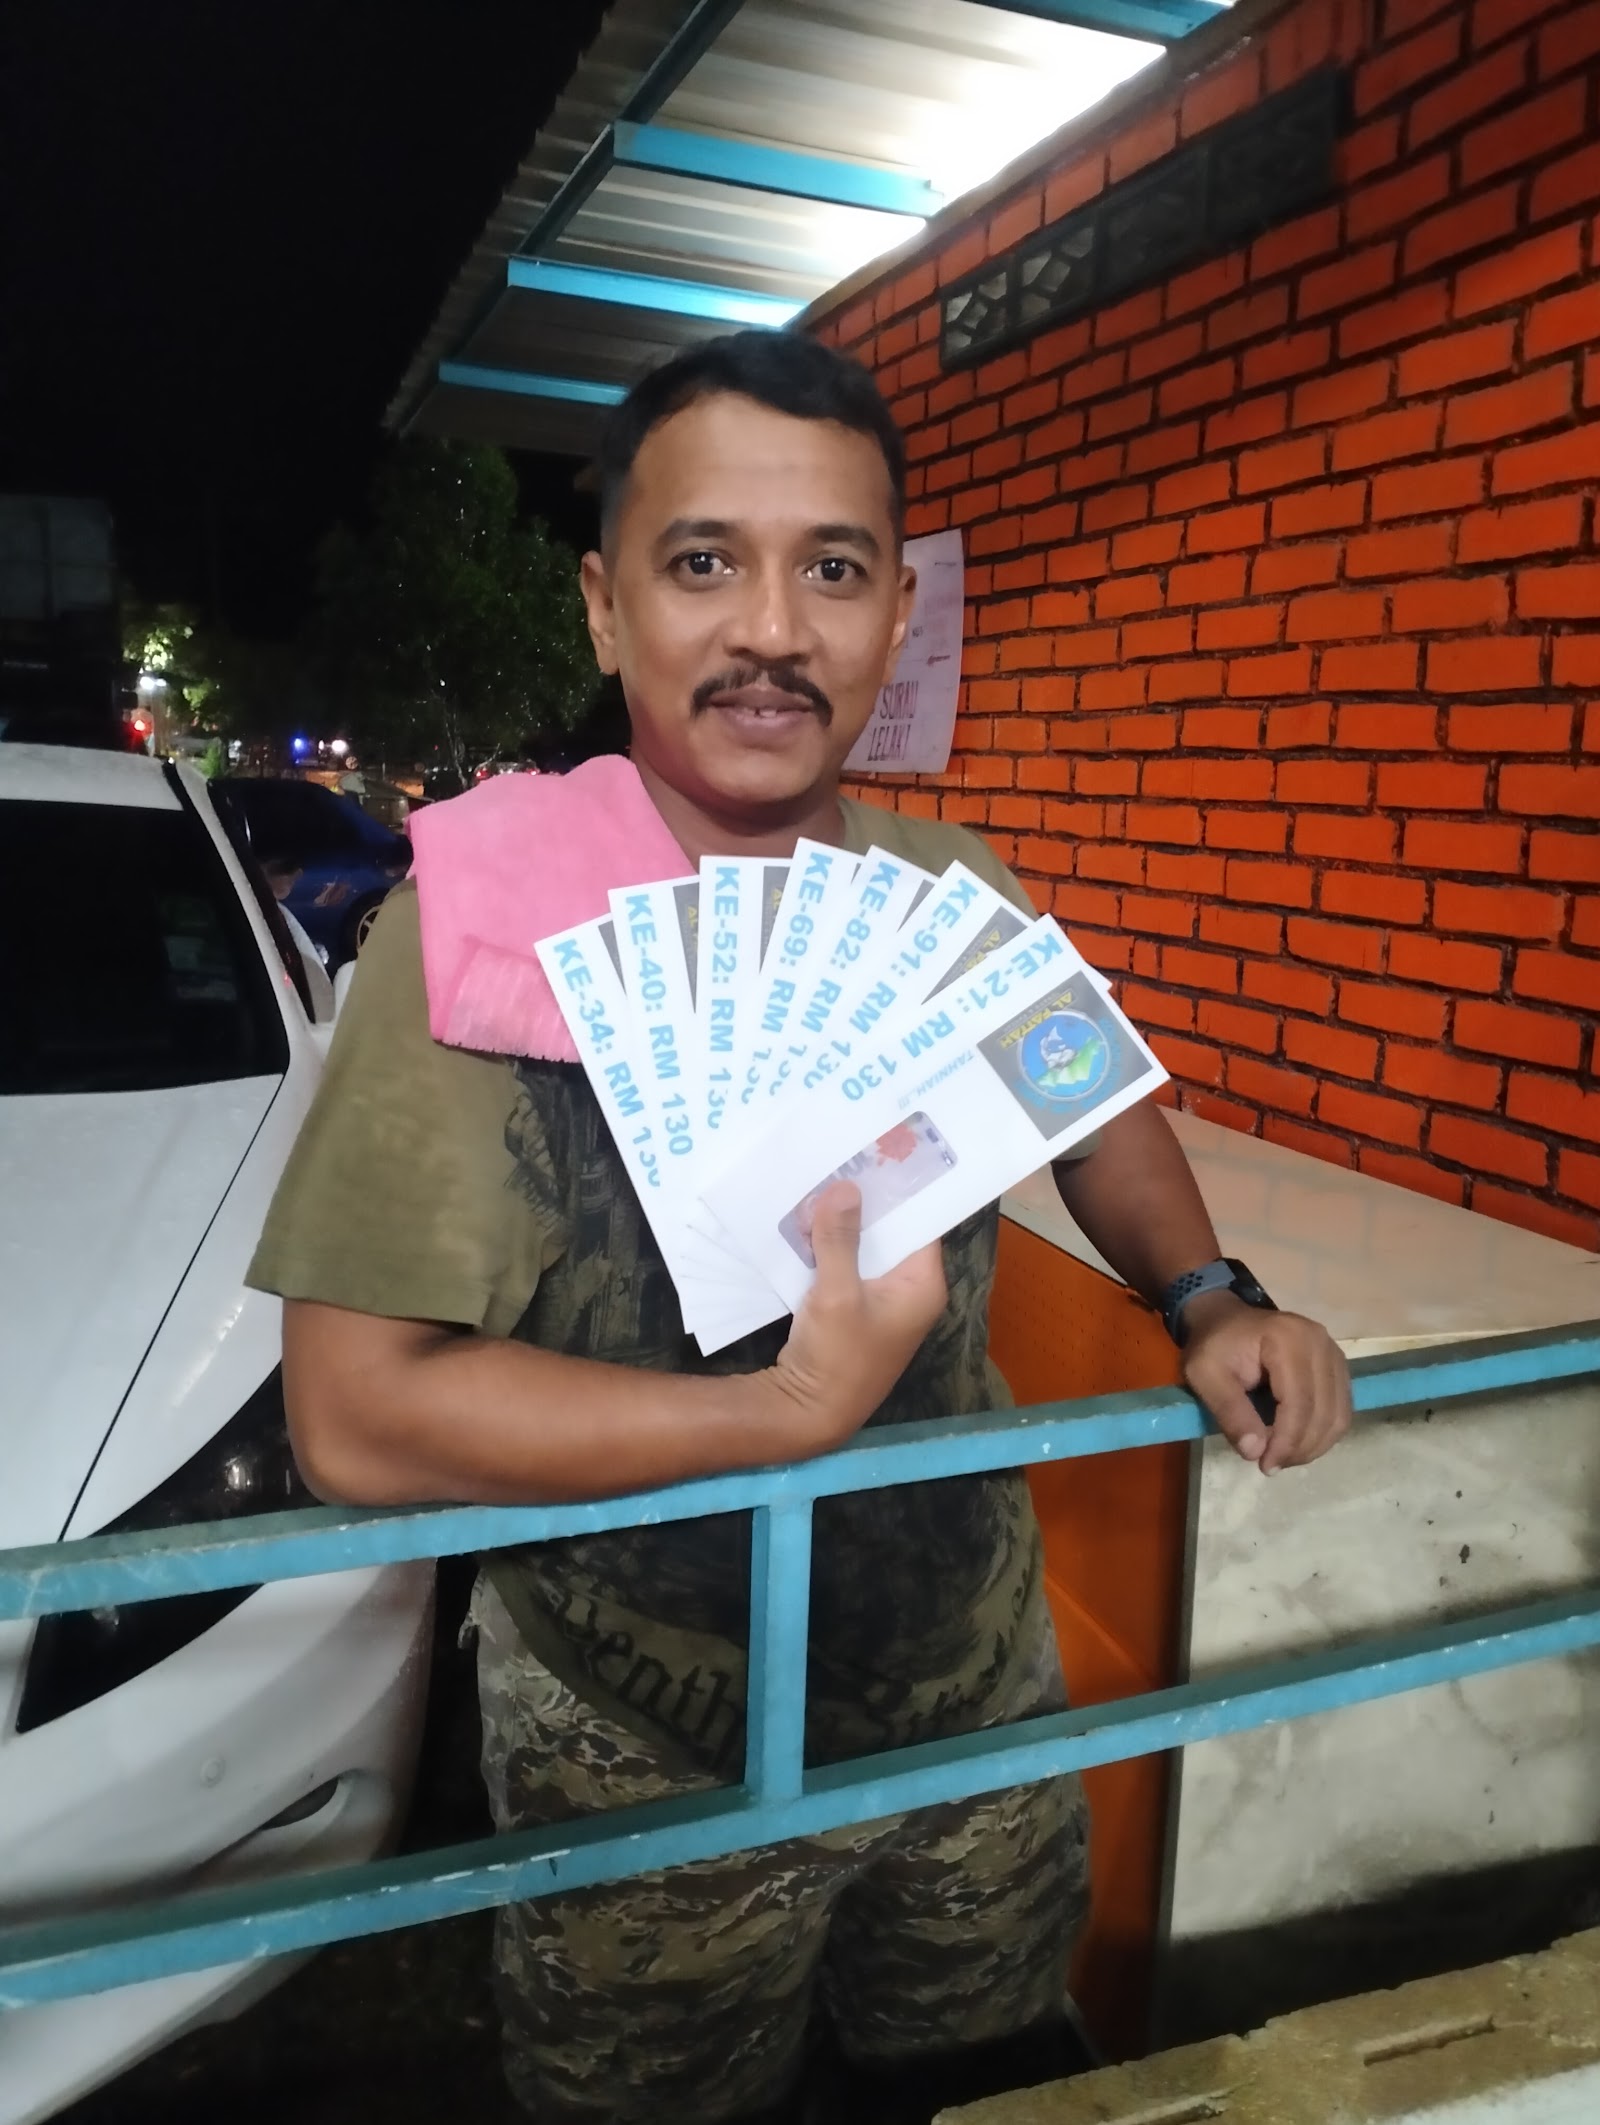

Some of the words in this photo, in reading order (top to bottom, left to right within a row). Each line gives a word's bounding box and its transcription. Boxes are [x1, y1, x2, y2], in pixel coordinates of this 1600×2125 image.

[879, 680, 919, 720] SURAU
[710, 865, 741, 984] KE-52:
[779, 851, 833, 968] KE-69:
[831, 860, 902, 970] KE-82:
[890, 879, 980, 976] KE-91:
[625, 893, 668, 1013] KE-40:
[958, 931, 1064, 1012] KE-21:
[553, 938, 616, 1056] KE-34:
[602, 1060, 647, 1118] RM
[709, 997, 736, 1054] RM
[760, 977, 797, 1035] RM
[800, 977, 843, 1034] RM
[848, 980, 897, 1035] RM
[1001, 1008, 1052, 1048] FATTAH
[1052, 991, 1073, 1011] AL
[648, 1024, 682, 1080] RM
[900, 1010, 956, 1060] RM
[840, 1054, 897, 1103] 130
[661, 1093, 694, 1157] 130
